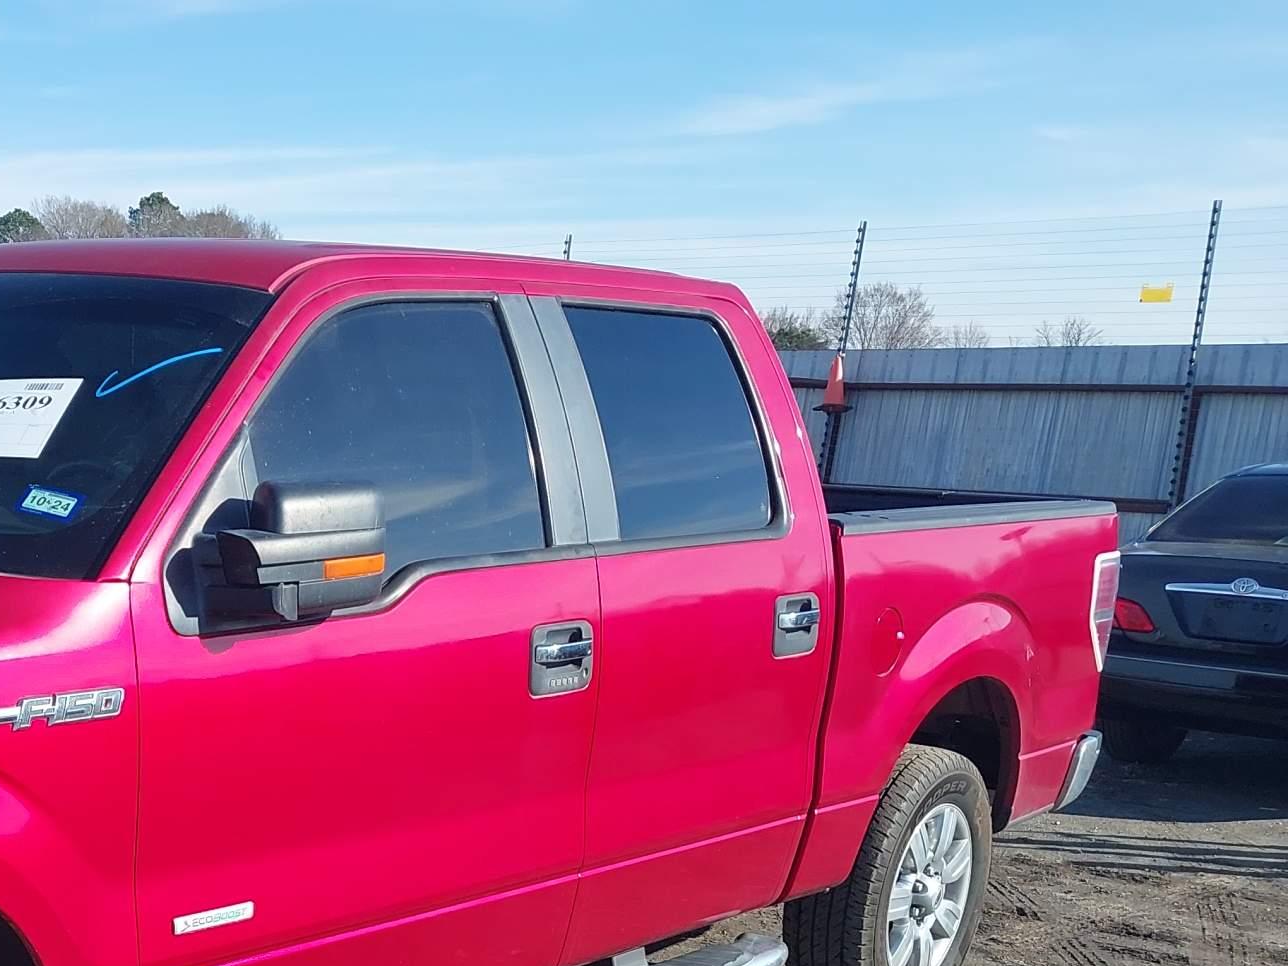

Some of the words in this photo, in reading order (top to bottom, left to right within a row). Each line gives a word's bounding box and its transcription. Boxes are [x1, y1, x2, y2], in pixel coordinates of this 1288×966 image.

[29, 495, 47, 506] 10
[50, 500, 72, 512] 24
[12, 686, 126, 731] F-150
[915, 780, 969, 824] COOPER
[191, 906, 249, 928] ECOBOOST
